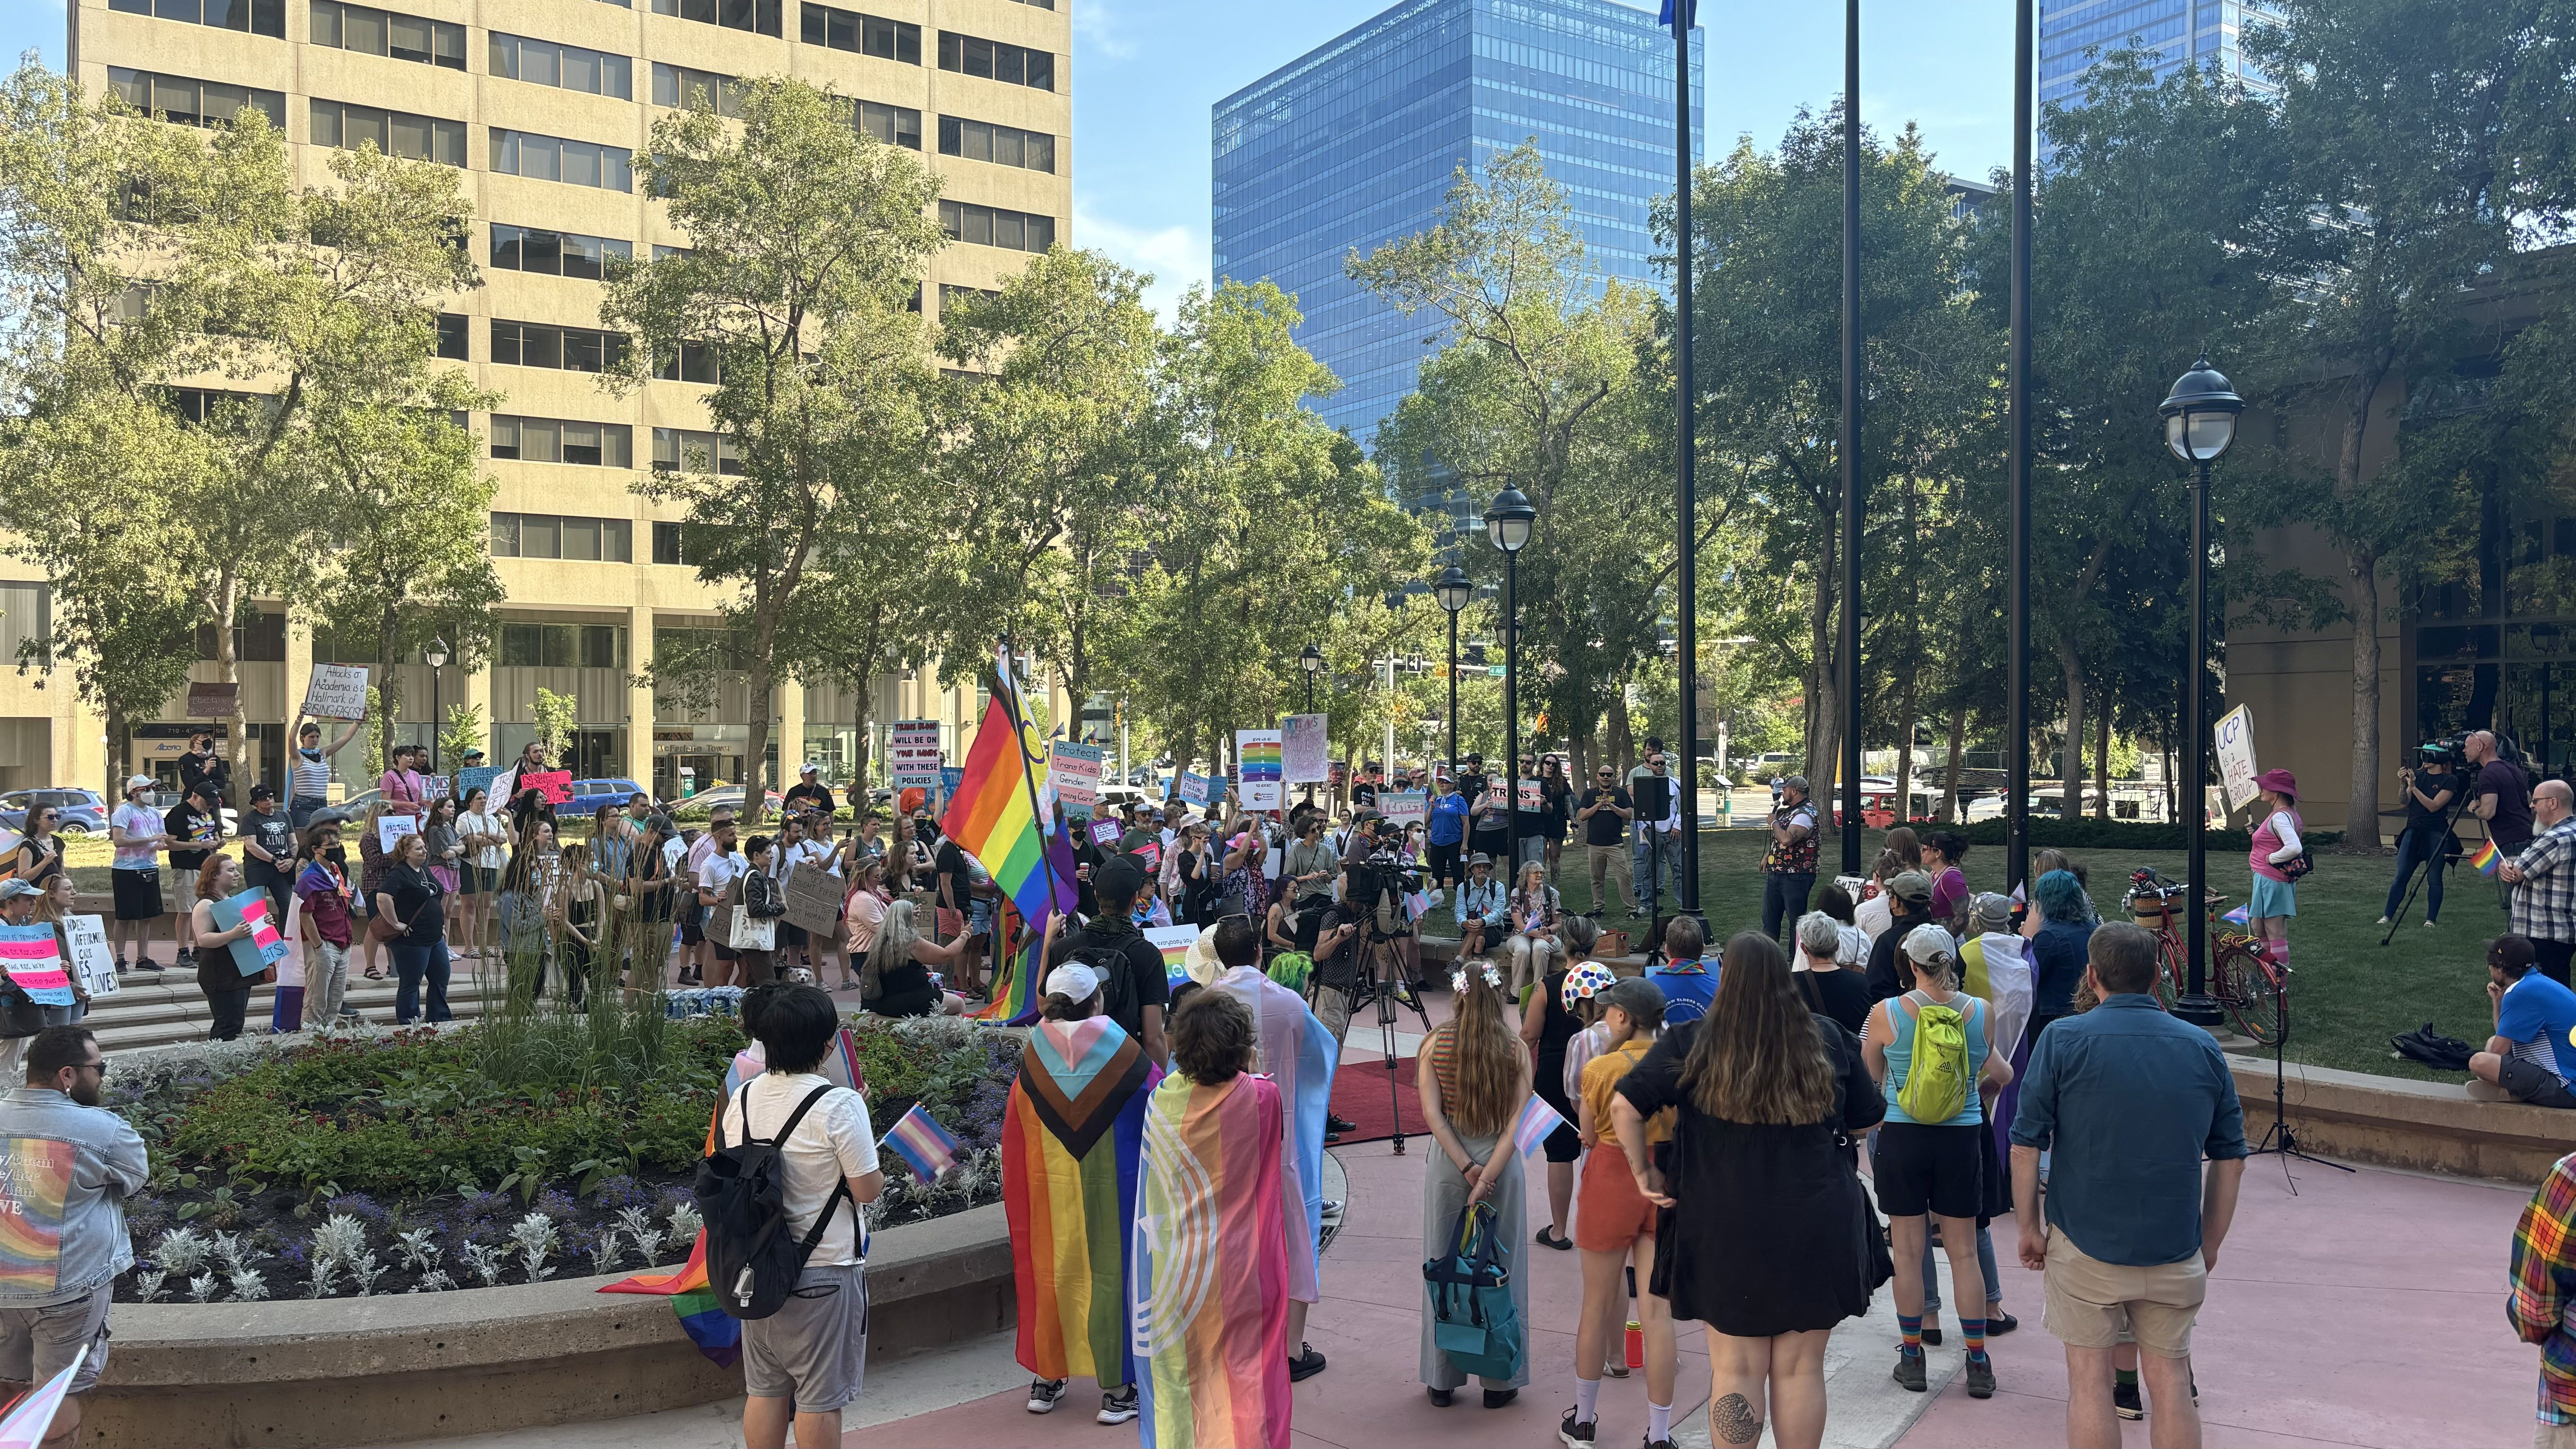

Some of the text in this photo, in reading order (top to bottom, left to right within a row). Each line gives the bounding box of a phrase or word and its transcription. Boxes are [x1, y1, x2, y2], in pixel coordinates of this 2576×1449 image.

[314, 678, 350, 691] Academia
[353, 684, 358, 692] is
[311, 690, 358, 704] Hallmark of
[306, 703, 334, 715] RISING
[2217, 716, 2239, 750] UCP
[897, 749, 937, 758] YOUR HANDS
[1058, 744, 1097, 758] Protect
[1056, 759, 1077, 770] Trans
[2222, 753, 2235, 768] is a
[473, 767, 502, 776] STUDENTS
[2228, 759, 2248, 787] HATE
[1060, 774, 1086, 786] Gender
[1078, 792, 1093, 802] Care
[1492, 787, 1530, 799] TRNS
[2230, 777, 2252, 806] GROUP
[386, 824, 409, 832] PROTECT
[267, 835, 285, 845] KIND
[797, 863, 838, 884] I WISH THE
[811, 876, 823, 886] UCP
[1836, 879, 1863, 892] SMITH
[792, 877, 838, 899] FOUGHT FIRES
[790, 895, 803, 906] THE
[805, 901, 818, 912] WAY
[793, 915, 822, 931] RIGHTS
[805, 911, 826, 923] HUMAN
[91, 971, 117, 993] LIVES
